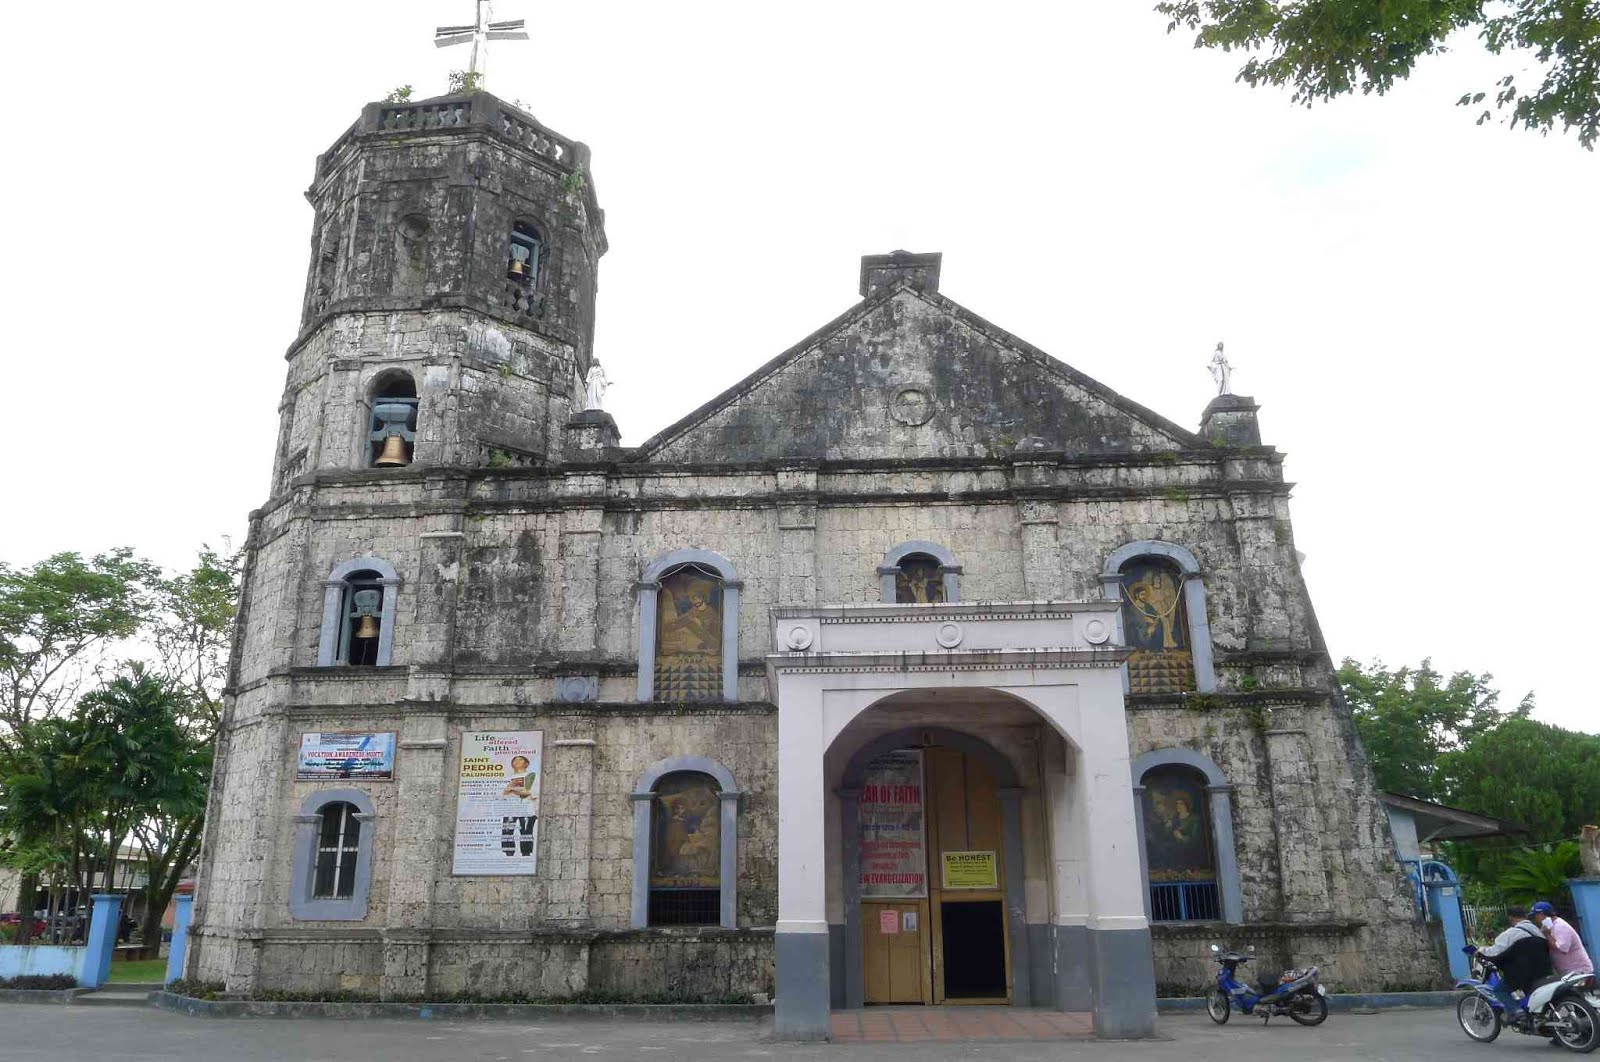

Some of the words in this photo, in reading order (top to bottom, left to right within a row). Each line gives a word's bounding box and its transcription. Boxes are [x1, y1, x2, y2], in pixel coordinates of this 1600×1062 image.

[880, 785, 891, 803] OF
[893, 785, 920, 804] FAITH
[958, 854, 992, 862] HONEST
